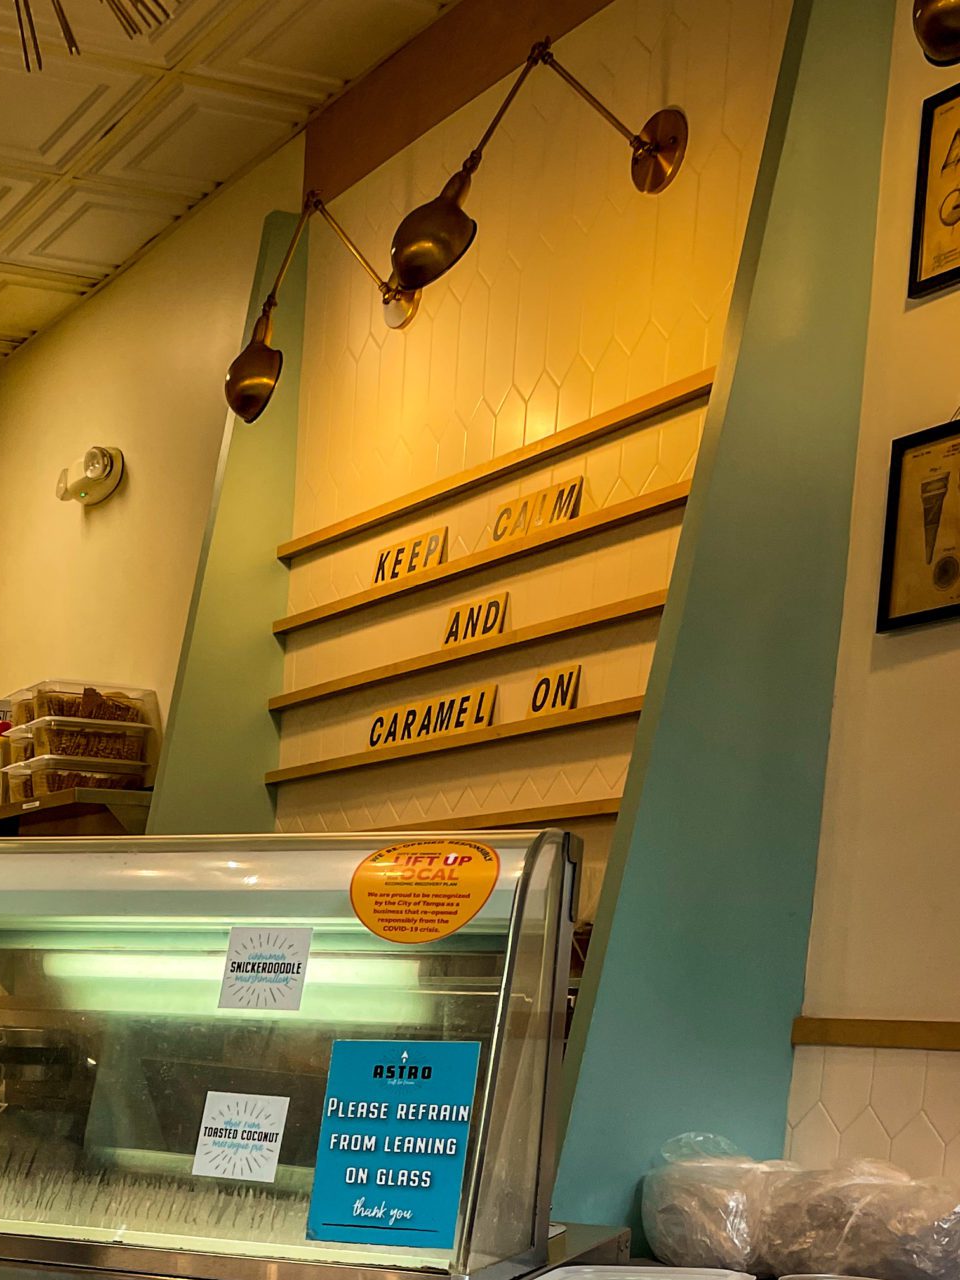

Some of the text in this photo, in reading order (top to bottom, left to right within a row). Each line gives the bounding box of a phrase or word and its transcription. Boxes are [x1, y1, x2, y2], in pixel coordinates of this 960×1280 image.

[374, 483, 578, 583] KEEP CALM
[444, 599, 499, 644] AND
[369, 671, 574, 748] CARAMEL ON
[443, 855, 473, 867] UP
[230, 961, 302, 975] SNICKERDOODLE
[372, 1064, 433, 1080] ASTRO
[327, 1097, 470, 1122] PLEASE REFRAIN
[203, 1126, 280, 1143] TOASTED COCONUT
[330, 1133, 457, 1155] FROM LEANING
[345, 1167, 432, 1188] ON GLASS
[352, 1197, 413, 1226] thank you
